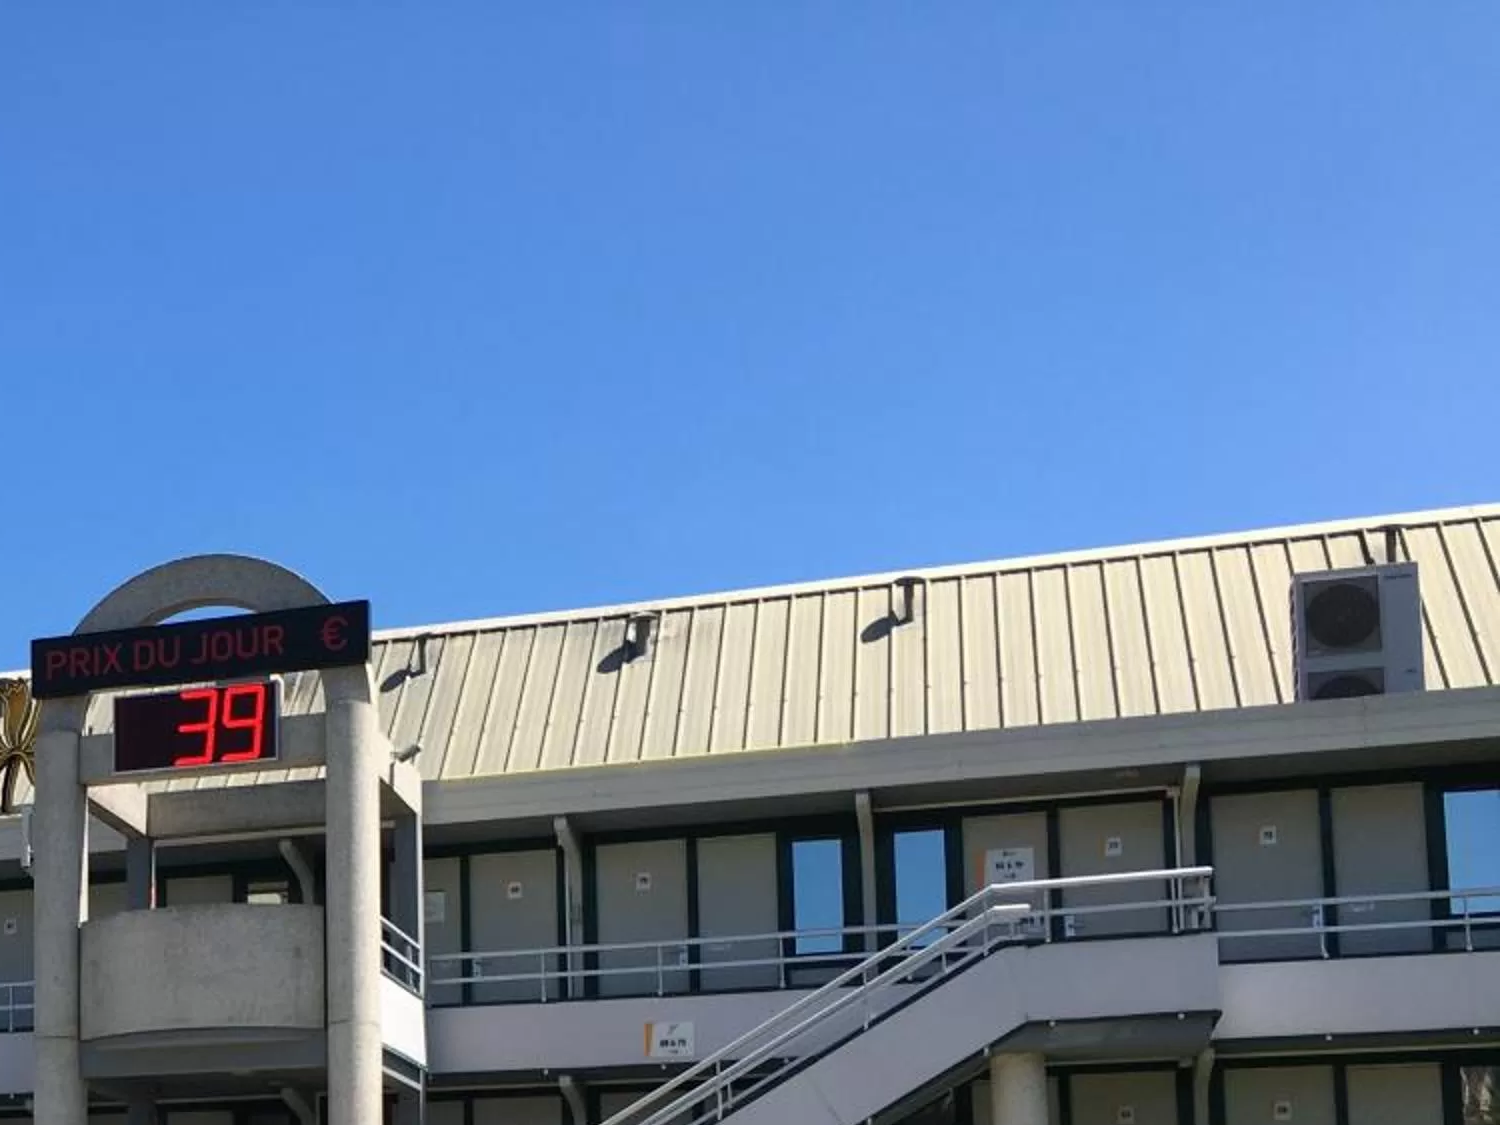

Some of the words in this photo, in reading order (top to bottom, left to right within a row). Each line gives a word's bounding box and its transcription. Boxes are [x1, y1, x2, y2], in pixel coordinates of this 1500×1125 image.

[44, 643, 122, 681] PRIX
[133, 639, 181, 672] DU
[190, 625, 285, 666] JOUR
[173, 682, 265, 768] 39
